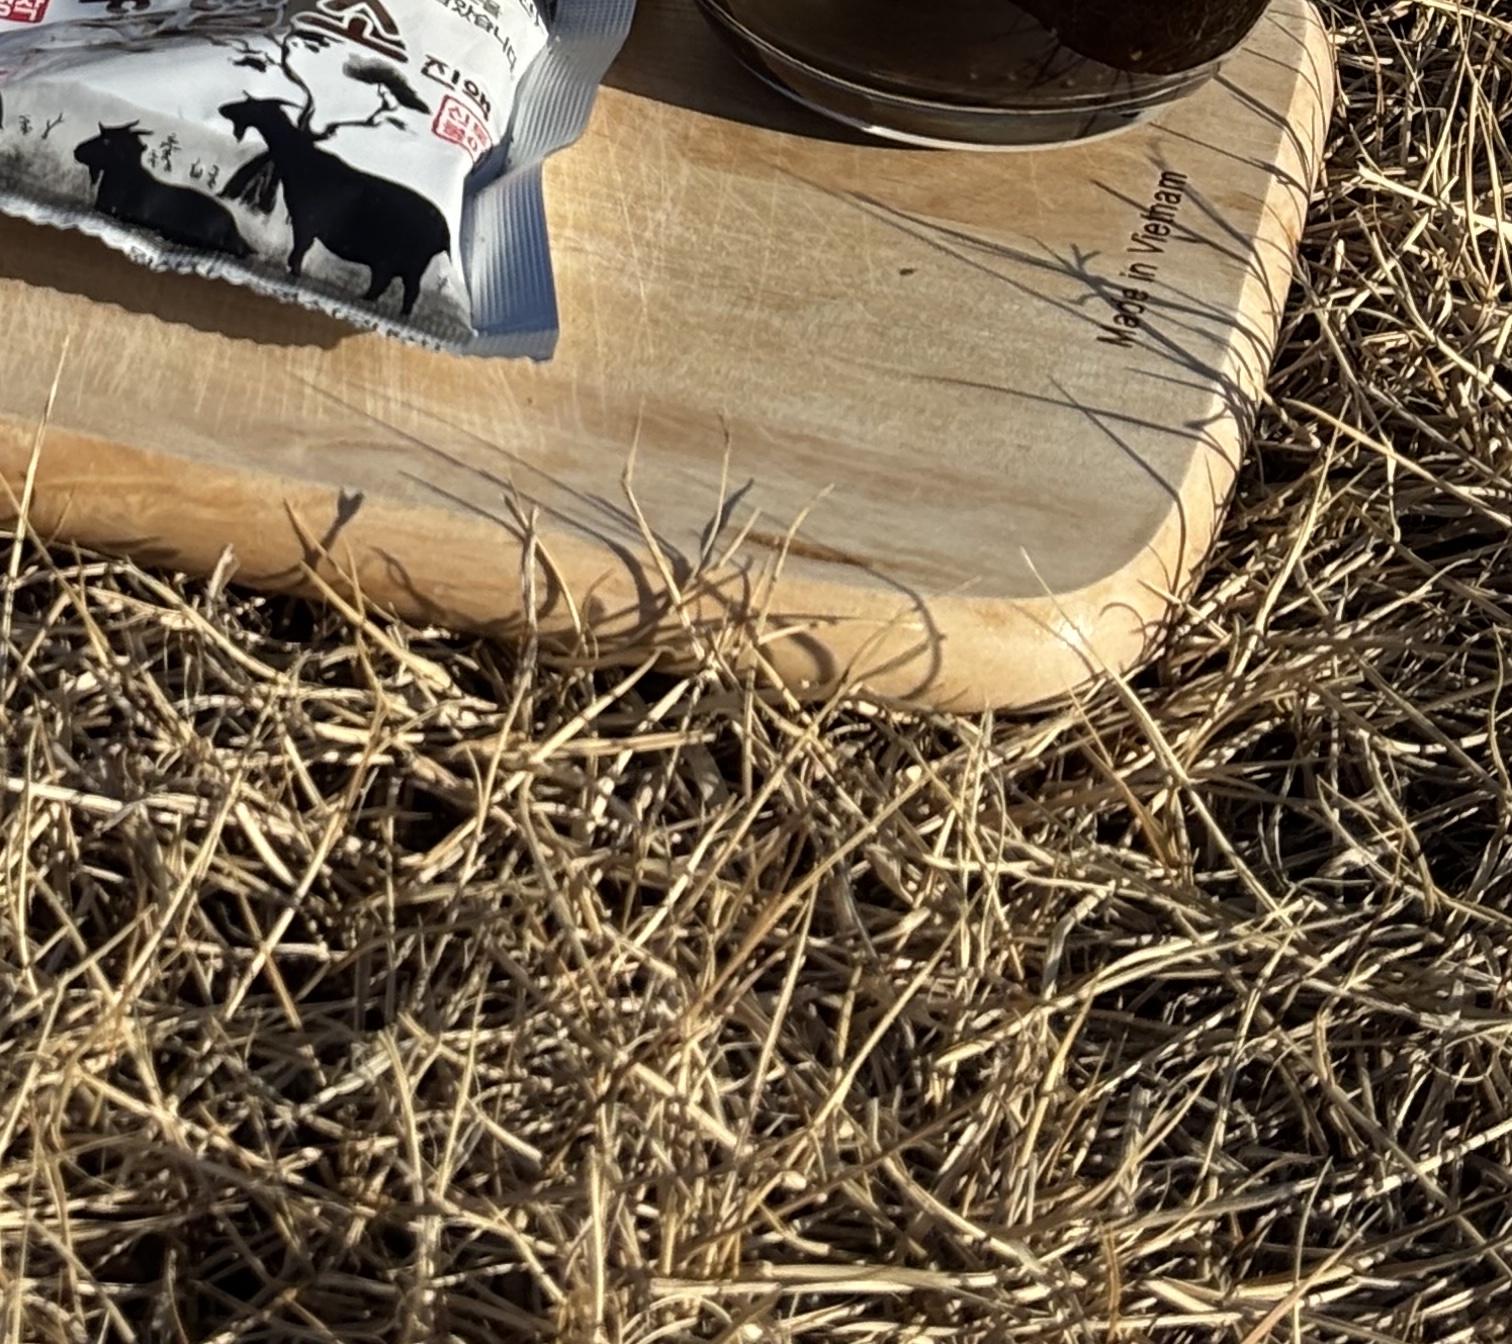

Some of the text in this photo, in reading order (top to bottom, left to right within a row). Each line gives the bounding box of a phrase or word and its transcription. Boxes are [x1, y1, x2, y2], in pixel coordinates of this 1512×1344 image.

[1096, 170, 1188, 349] Made in Vietnam
